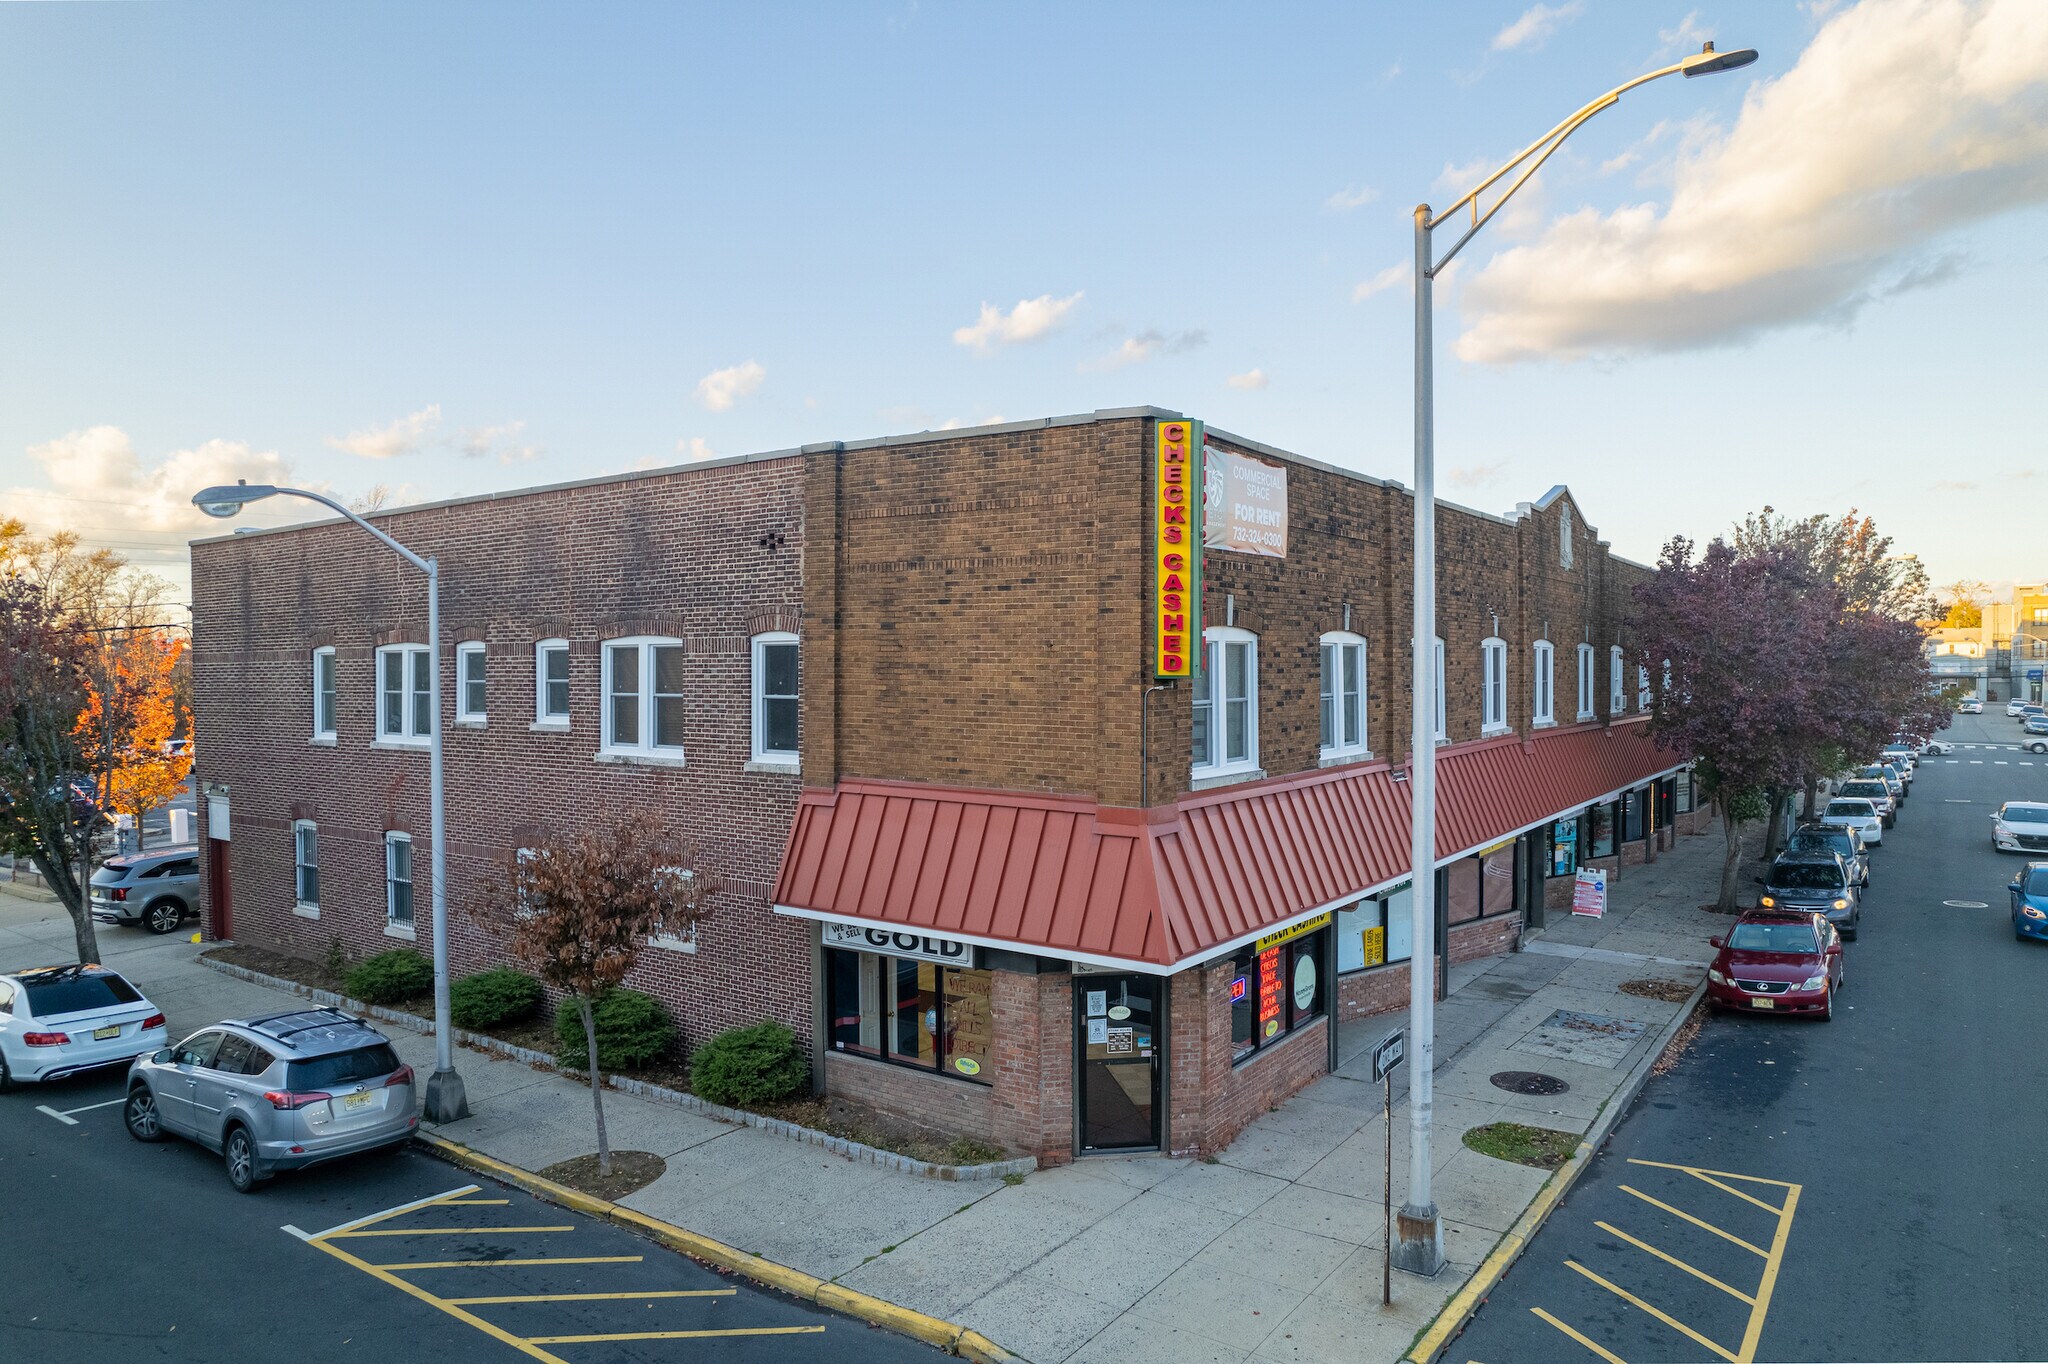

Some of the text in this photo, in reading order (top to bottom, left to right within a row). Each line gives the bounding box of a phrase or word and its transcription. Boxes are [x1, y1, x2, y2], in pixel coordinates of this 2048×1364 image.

[1233, 465, 1282, 490] COMMERCIAL
[1246, 483, 1270, 501] SPACE
[1235, 503, 1281, 528] FOR RENT
[1162, 423, 1185, 672] CHECKS CASHED
[831, 923, 844, 933] WE
[837, 928, 861, 940] & SELL
[865, 928, 963, 957] GOLD
